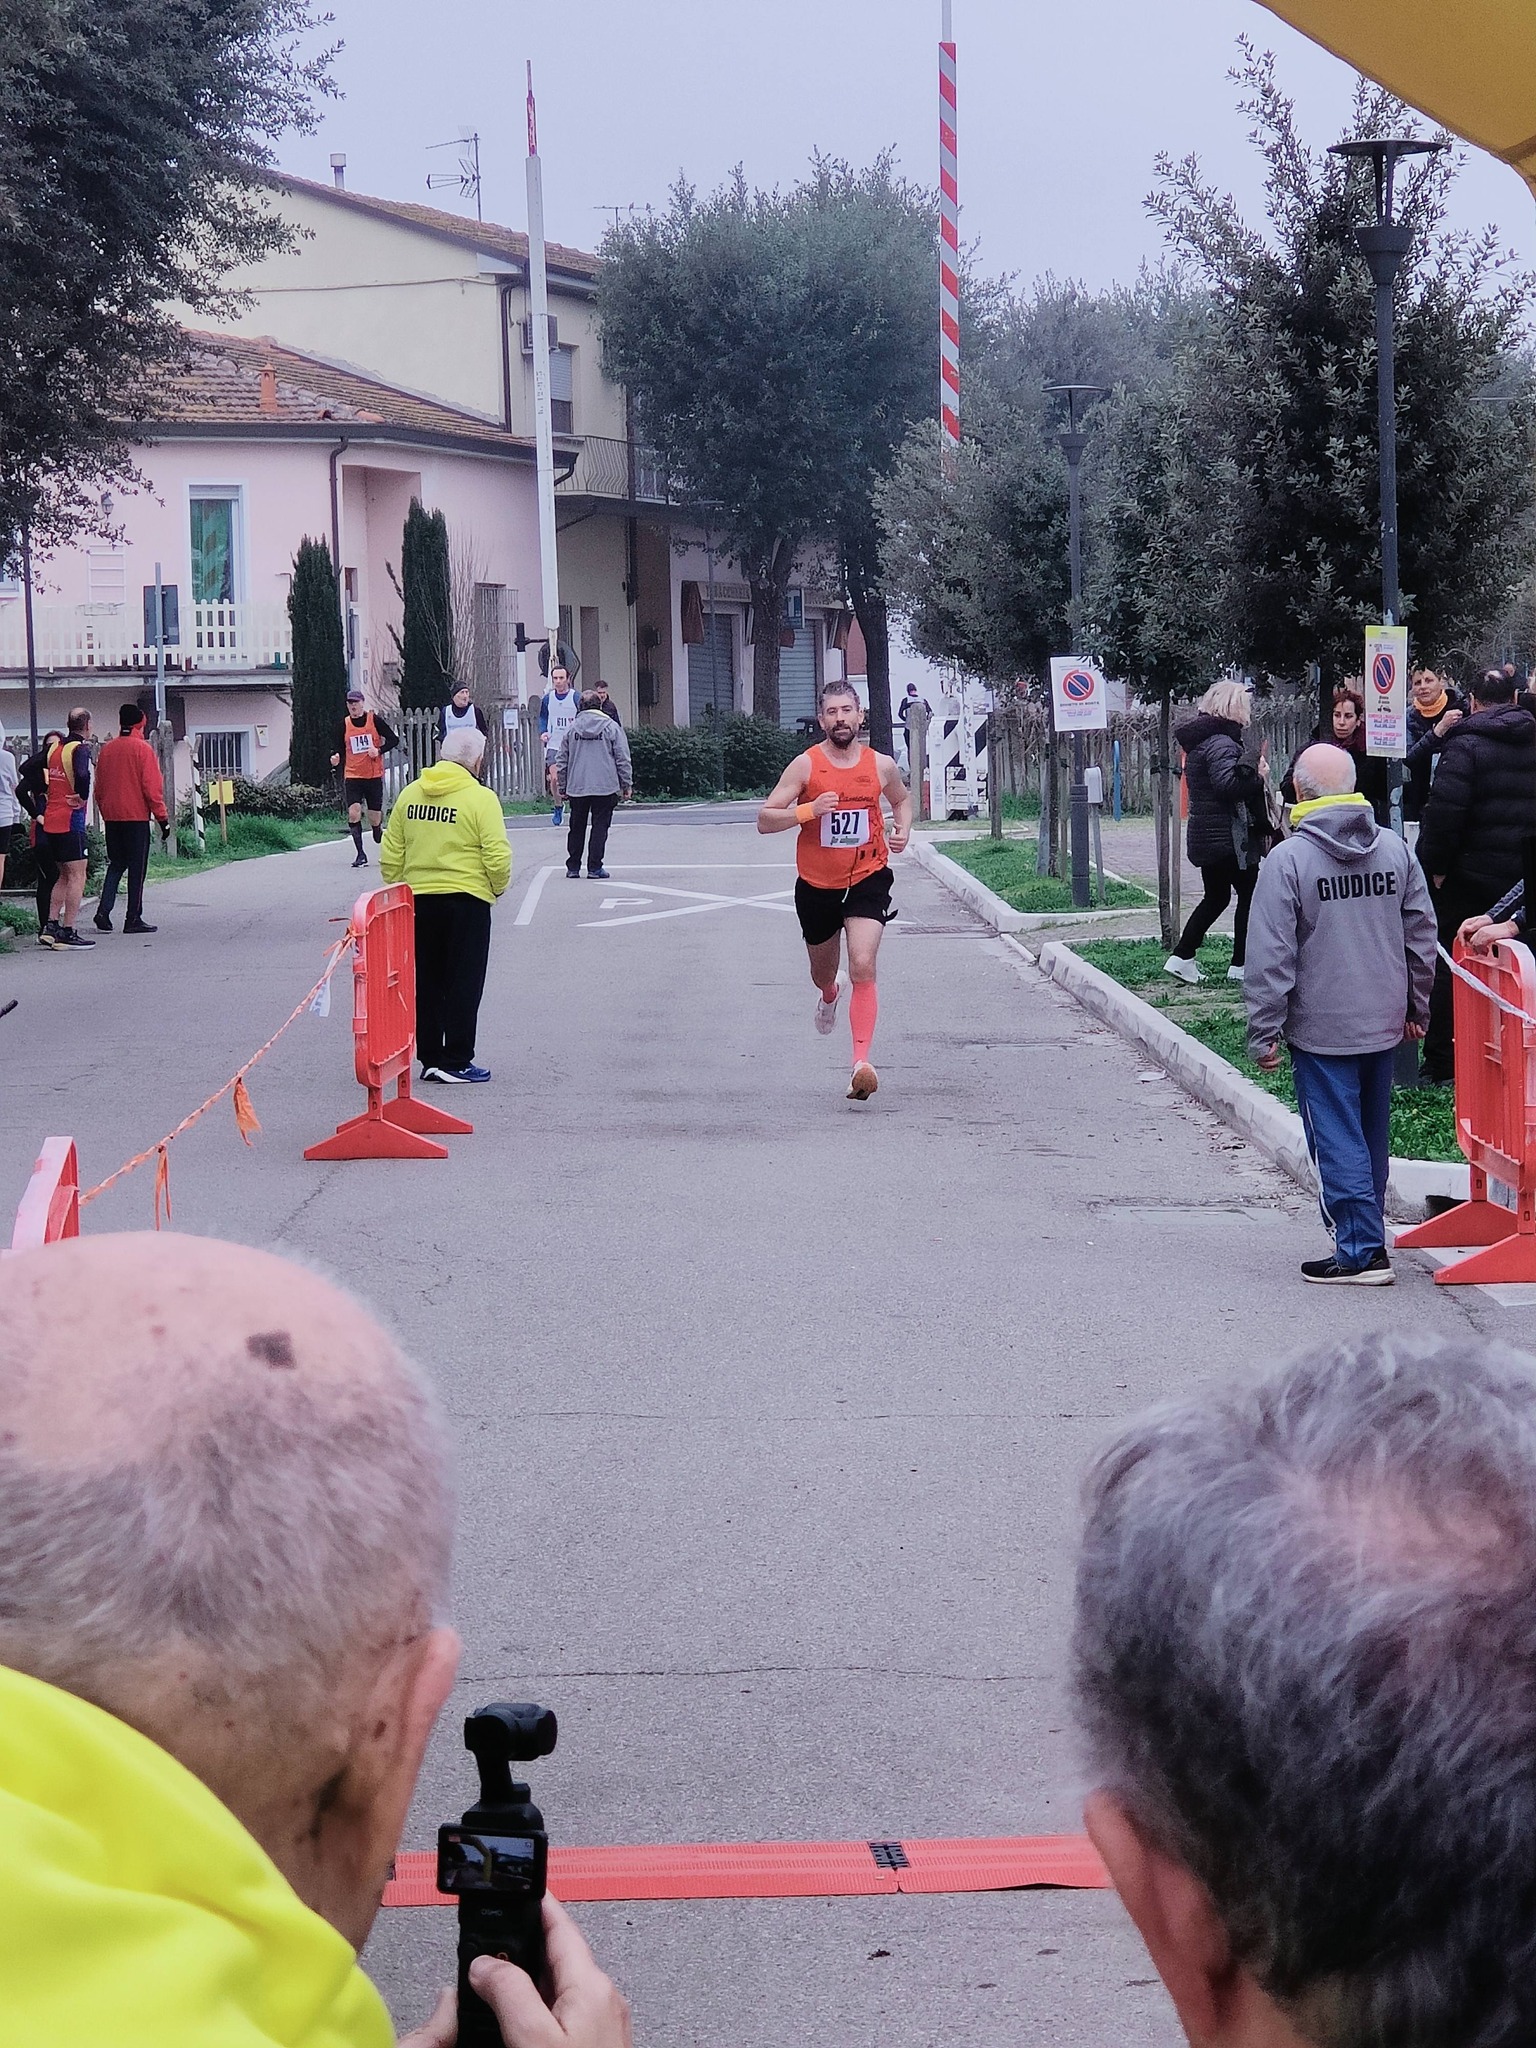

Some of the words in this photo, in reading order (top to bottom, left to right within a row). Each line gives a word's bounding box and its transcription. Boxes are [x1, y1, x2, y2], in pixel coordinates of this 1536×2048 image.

[355, 735, 369, 748] 744
[407, 804, 458, 824] GIUDICE
[831, 811, 860, 835] 527
[1317, 871, 1397, 902] GIUDICE
